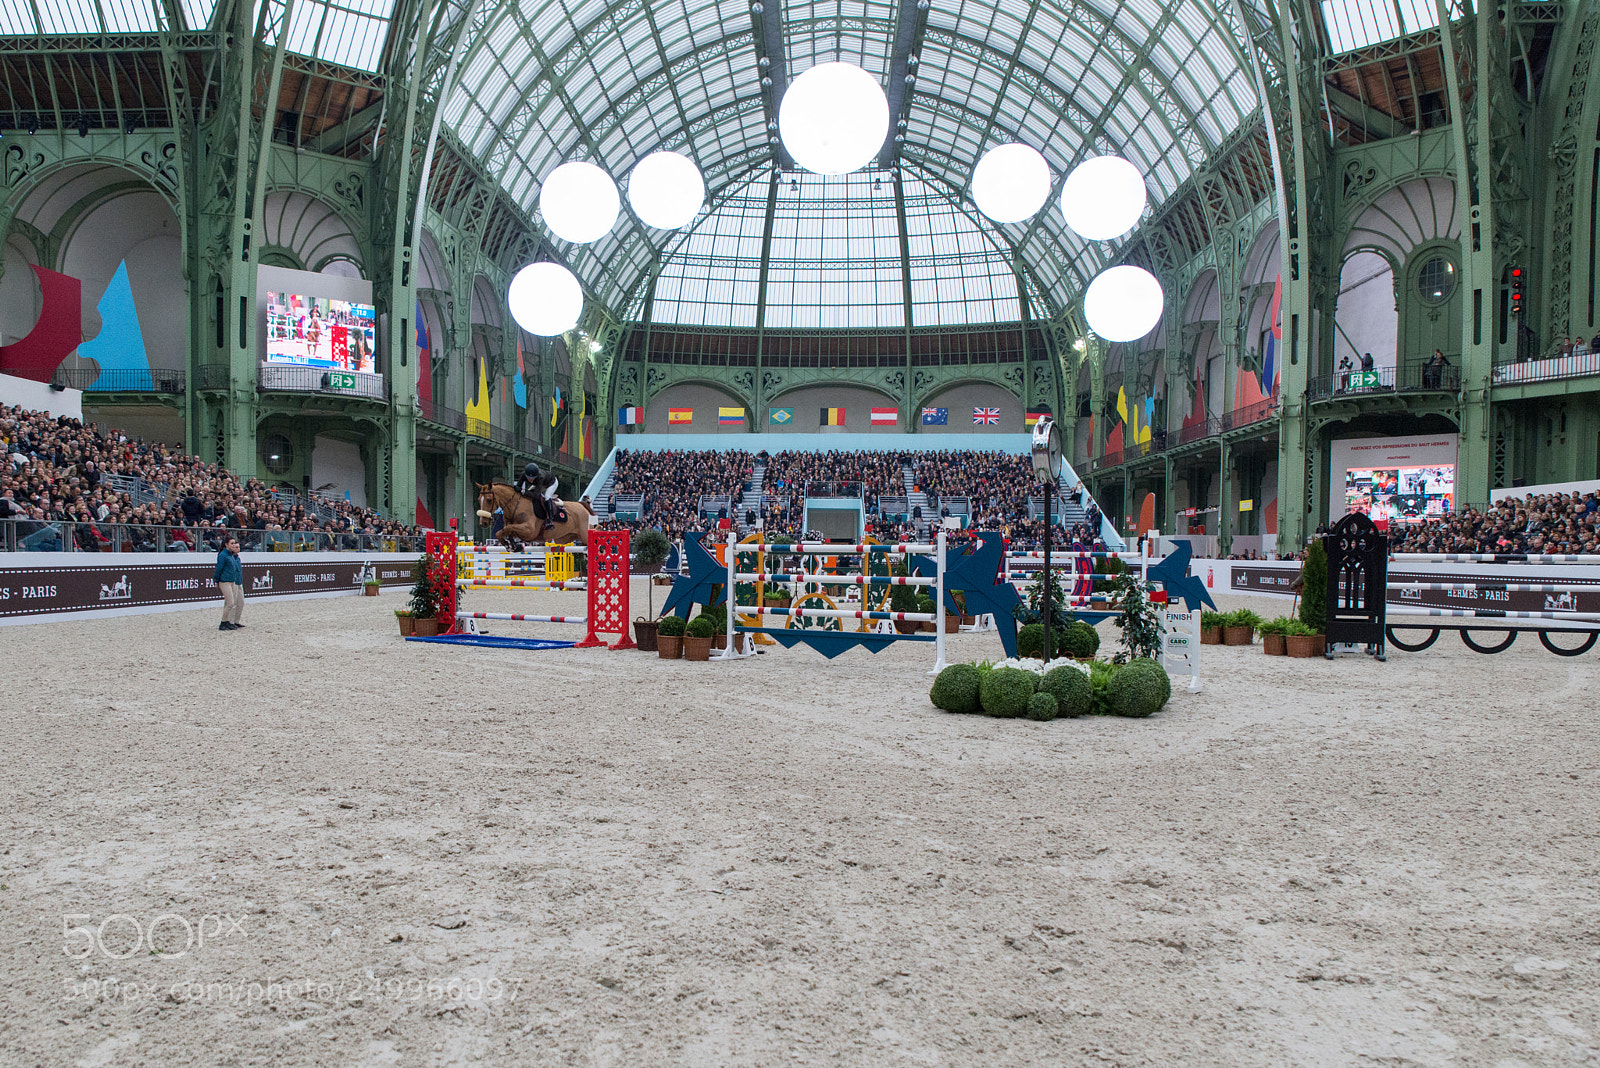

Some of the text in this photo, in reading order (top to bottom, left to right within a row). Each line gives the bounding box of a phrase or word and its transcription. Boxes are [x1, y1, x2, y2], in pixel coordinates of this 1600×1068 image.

[165, 577, 199, 590] HERMÈS
[294, 572, 317, 583] HERMÈS
[320, 573, 336, 582] PARIS
[22, 585, 57, 599] PARIS
[1484, 590, 1510, 602] PARIS
[1166, 613, 1192, 621] FINISH
[469, 619, 475, 632] 8
[877, 622, 883, 634] 9
[888, 622, 893, 634] 9
